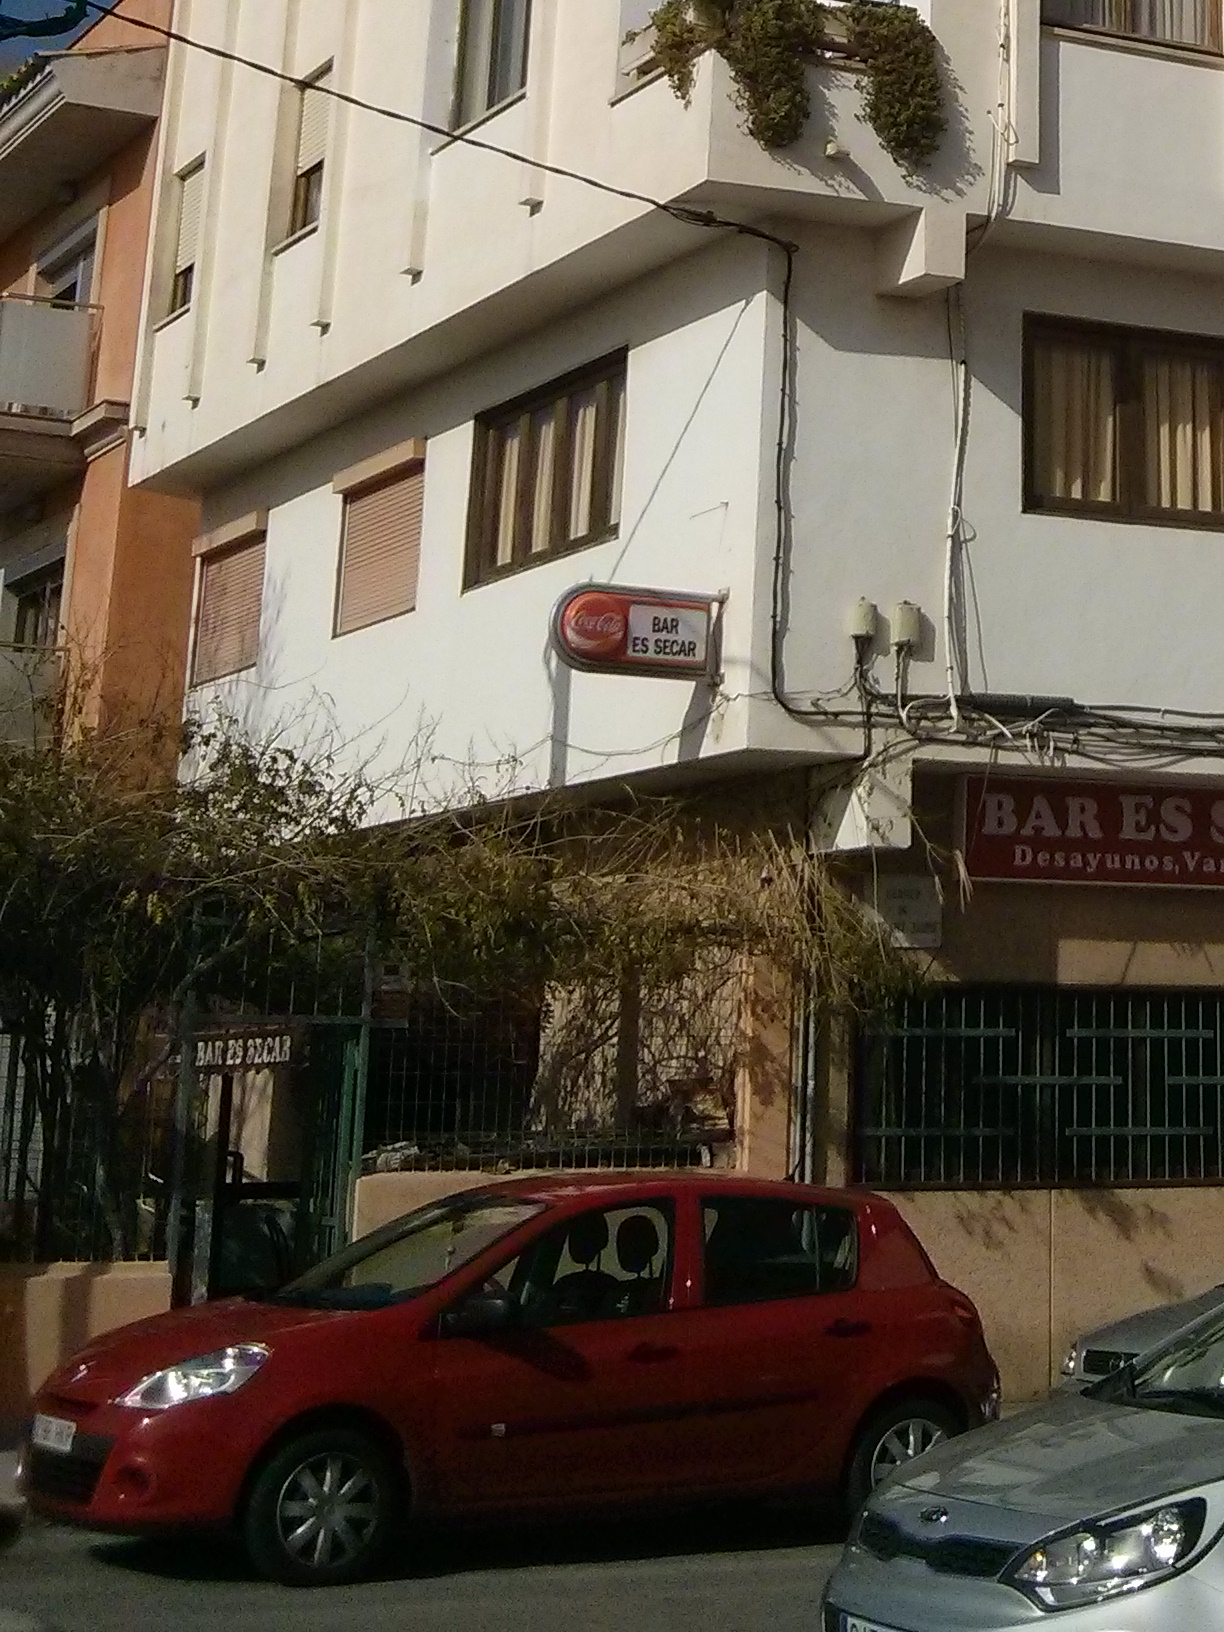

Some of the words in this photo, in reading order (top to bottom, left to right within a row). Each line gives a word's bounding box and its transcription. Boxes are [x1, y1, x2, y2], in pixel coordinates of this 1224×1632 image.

[652, 616, 680, 634] BAR
[632, 637, 649, 654] ES
[653, 638, 697, 657] SECAR
[981, 792, 1103, 840] BAR
[1117, 795, 1194, 843] ES
[195, 1040, 224, 1066] BAR
[225, 1038, 244, 1065] ES
[245, 1035, 292, 1065] SECAR
